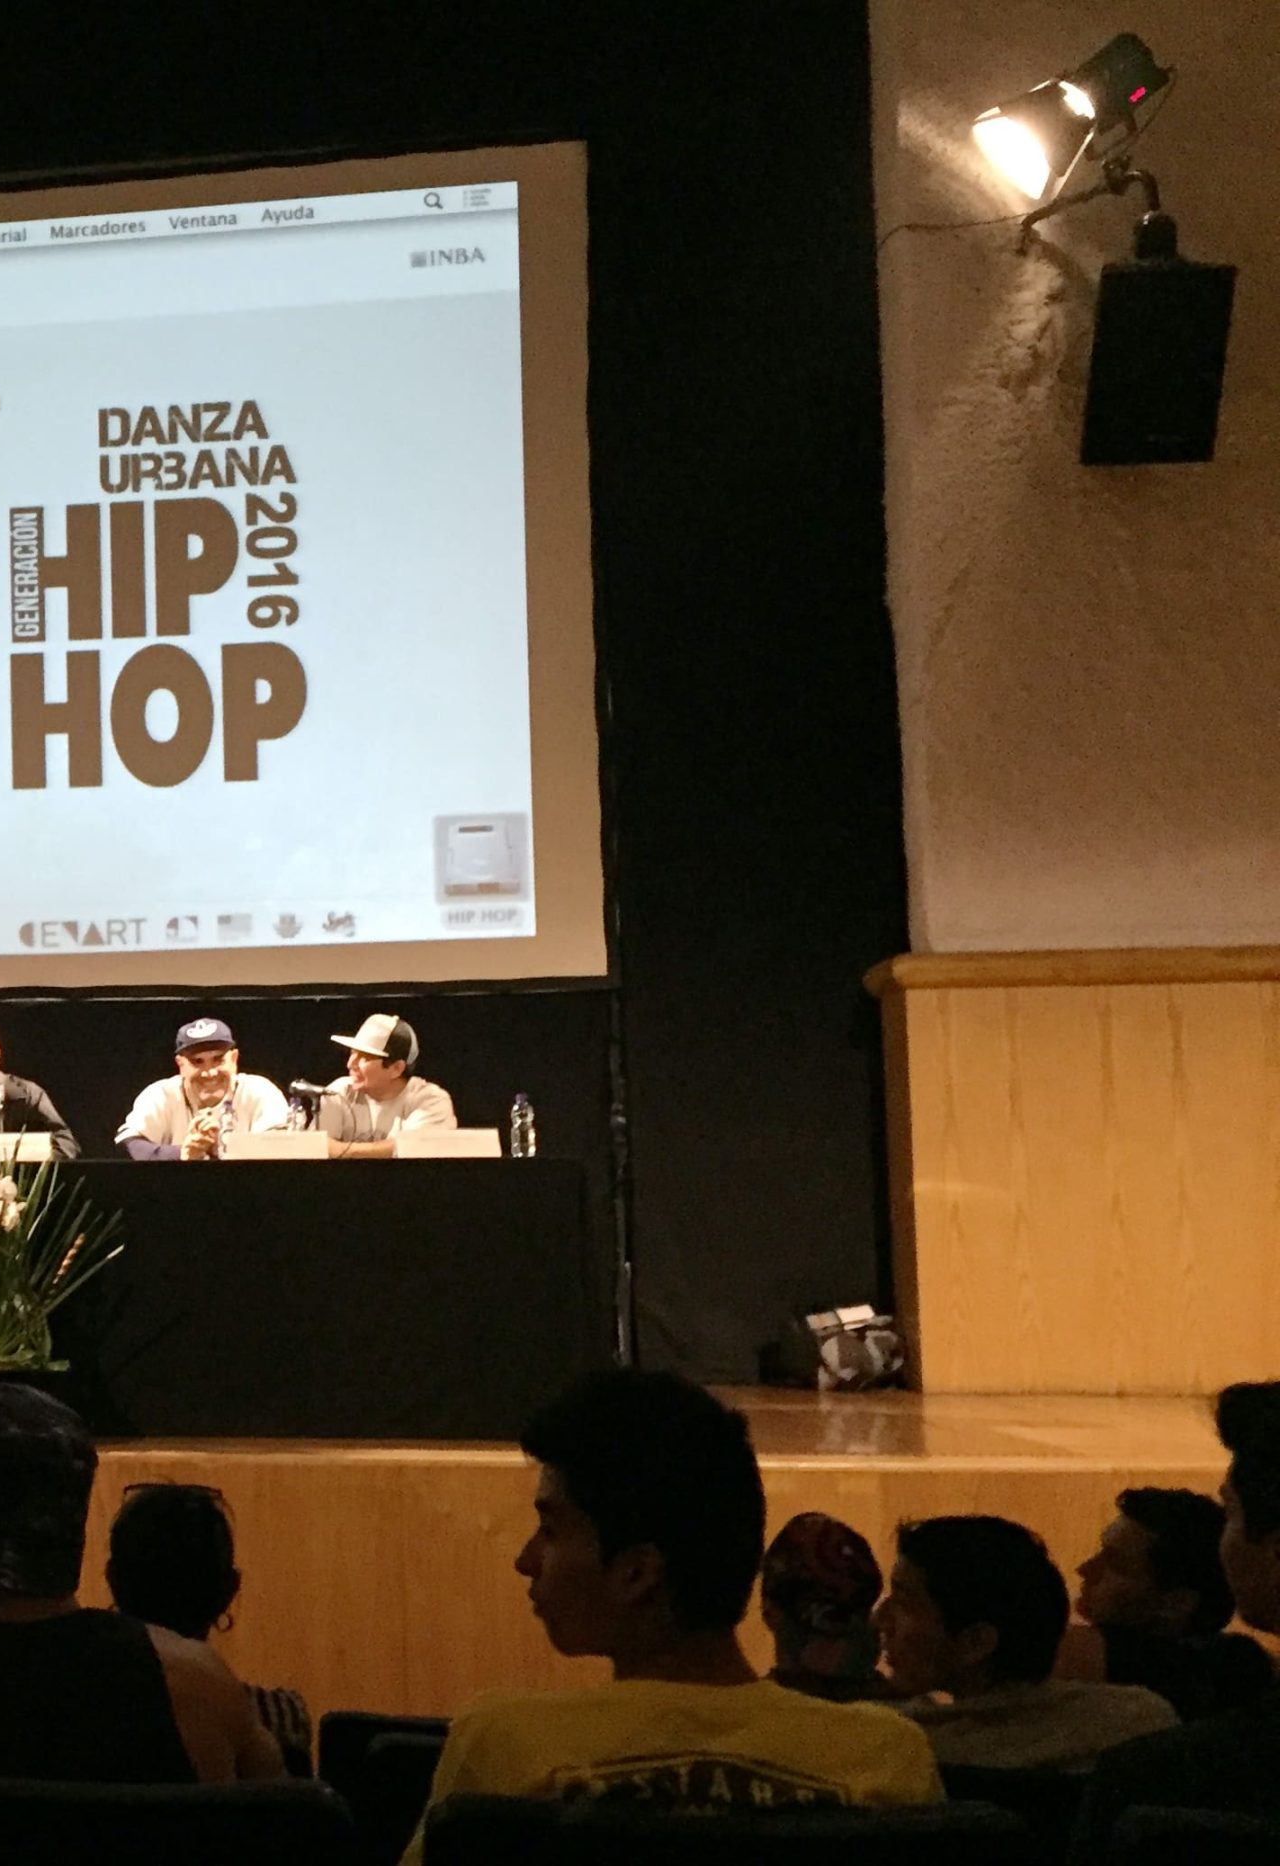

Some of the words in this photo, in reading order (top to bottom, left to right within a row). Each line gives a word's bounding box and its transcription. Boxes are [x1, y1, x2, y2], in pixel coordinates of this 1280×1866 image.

[50, 218, 146, 240] Marcadores
[169, 211, 238, 231] Ventana
[261, 205, 315, 224] Ayuda
[429, 246, 486, 266] INBA
[98, 400, 269, 448] DANZA
[10, 497, 239, 643] HIP
[245, 492, 299, 629] 2016
[10, 641, 308, 790] HOP
